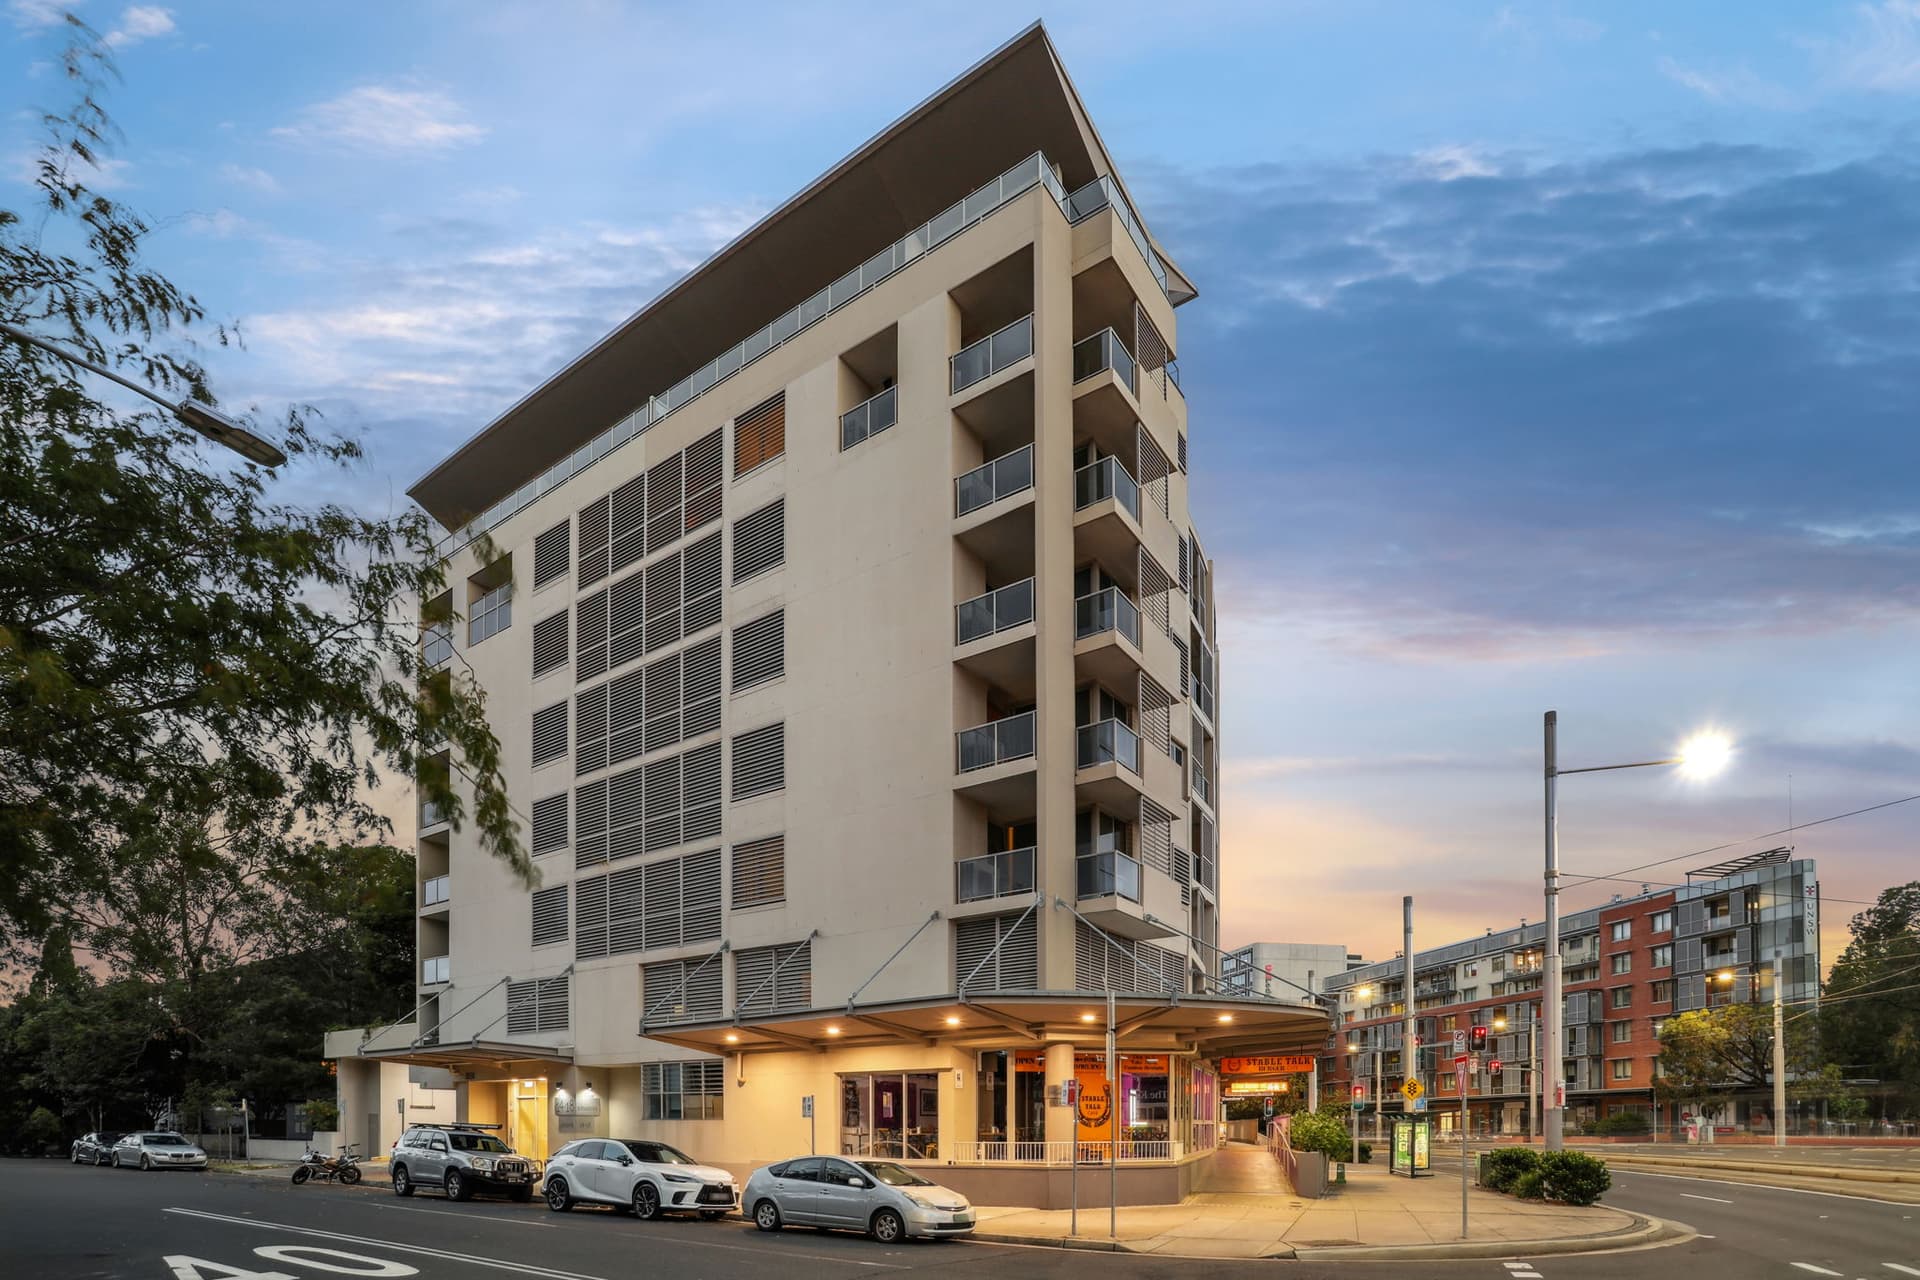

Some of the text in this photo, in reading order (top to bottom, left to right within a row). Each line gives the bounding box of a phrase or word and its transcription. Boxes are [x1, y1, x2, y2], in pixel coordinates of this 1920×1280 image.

[1806, 903, 1816, 935] UNSW
[1246, 1057, 1310, 1066] STABLE TALK
